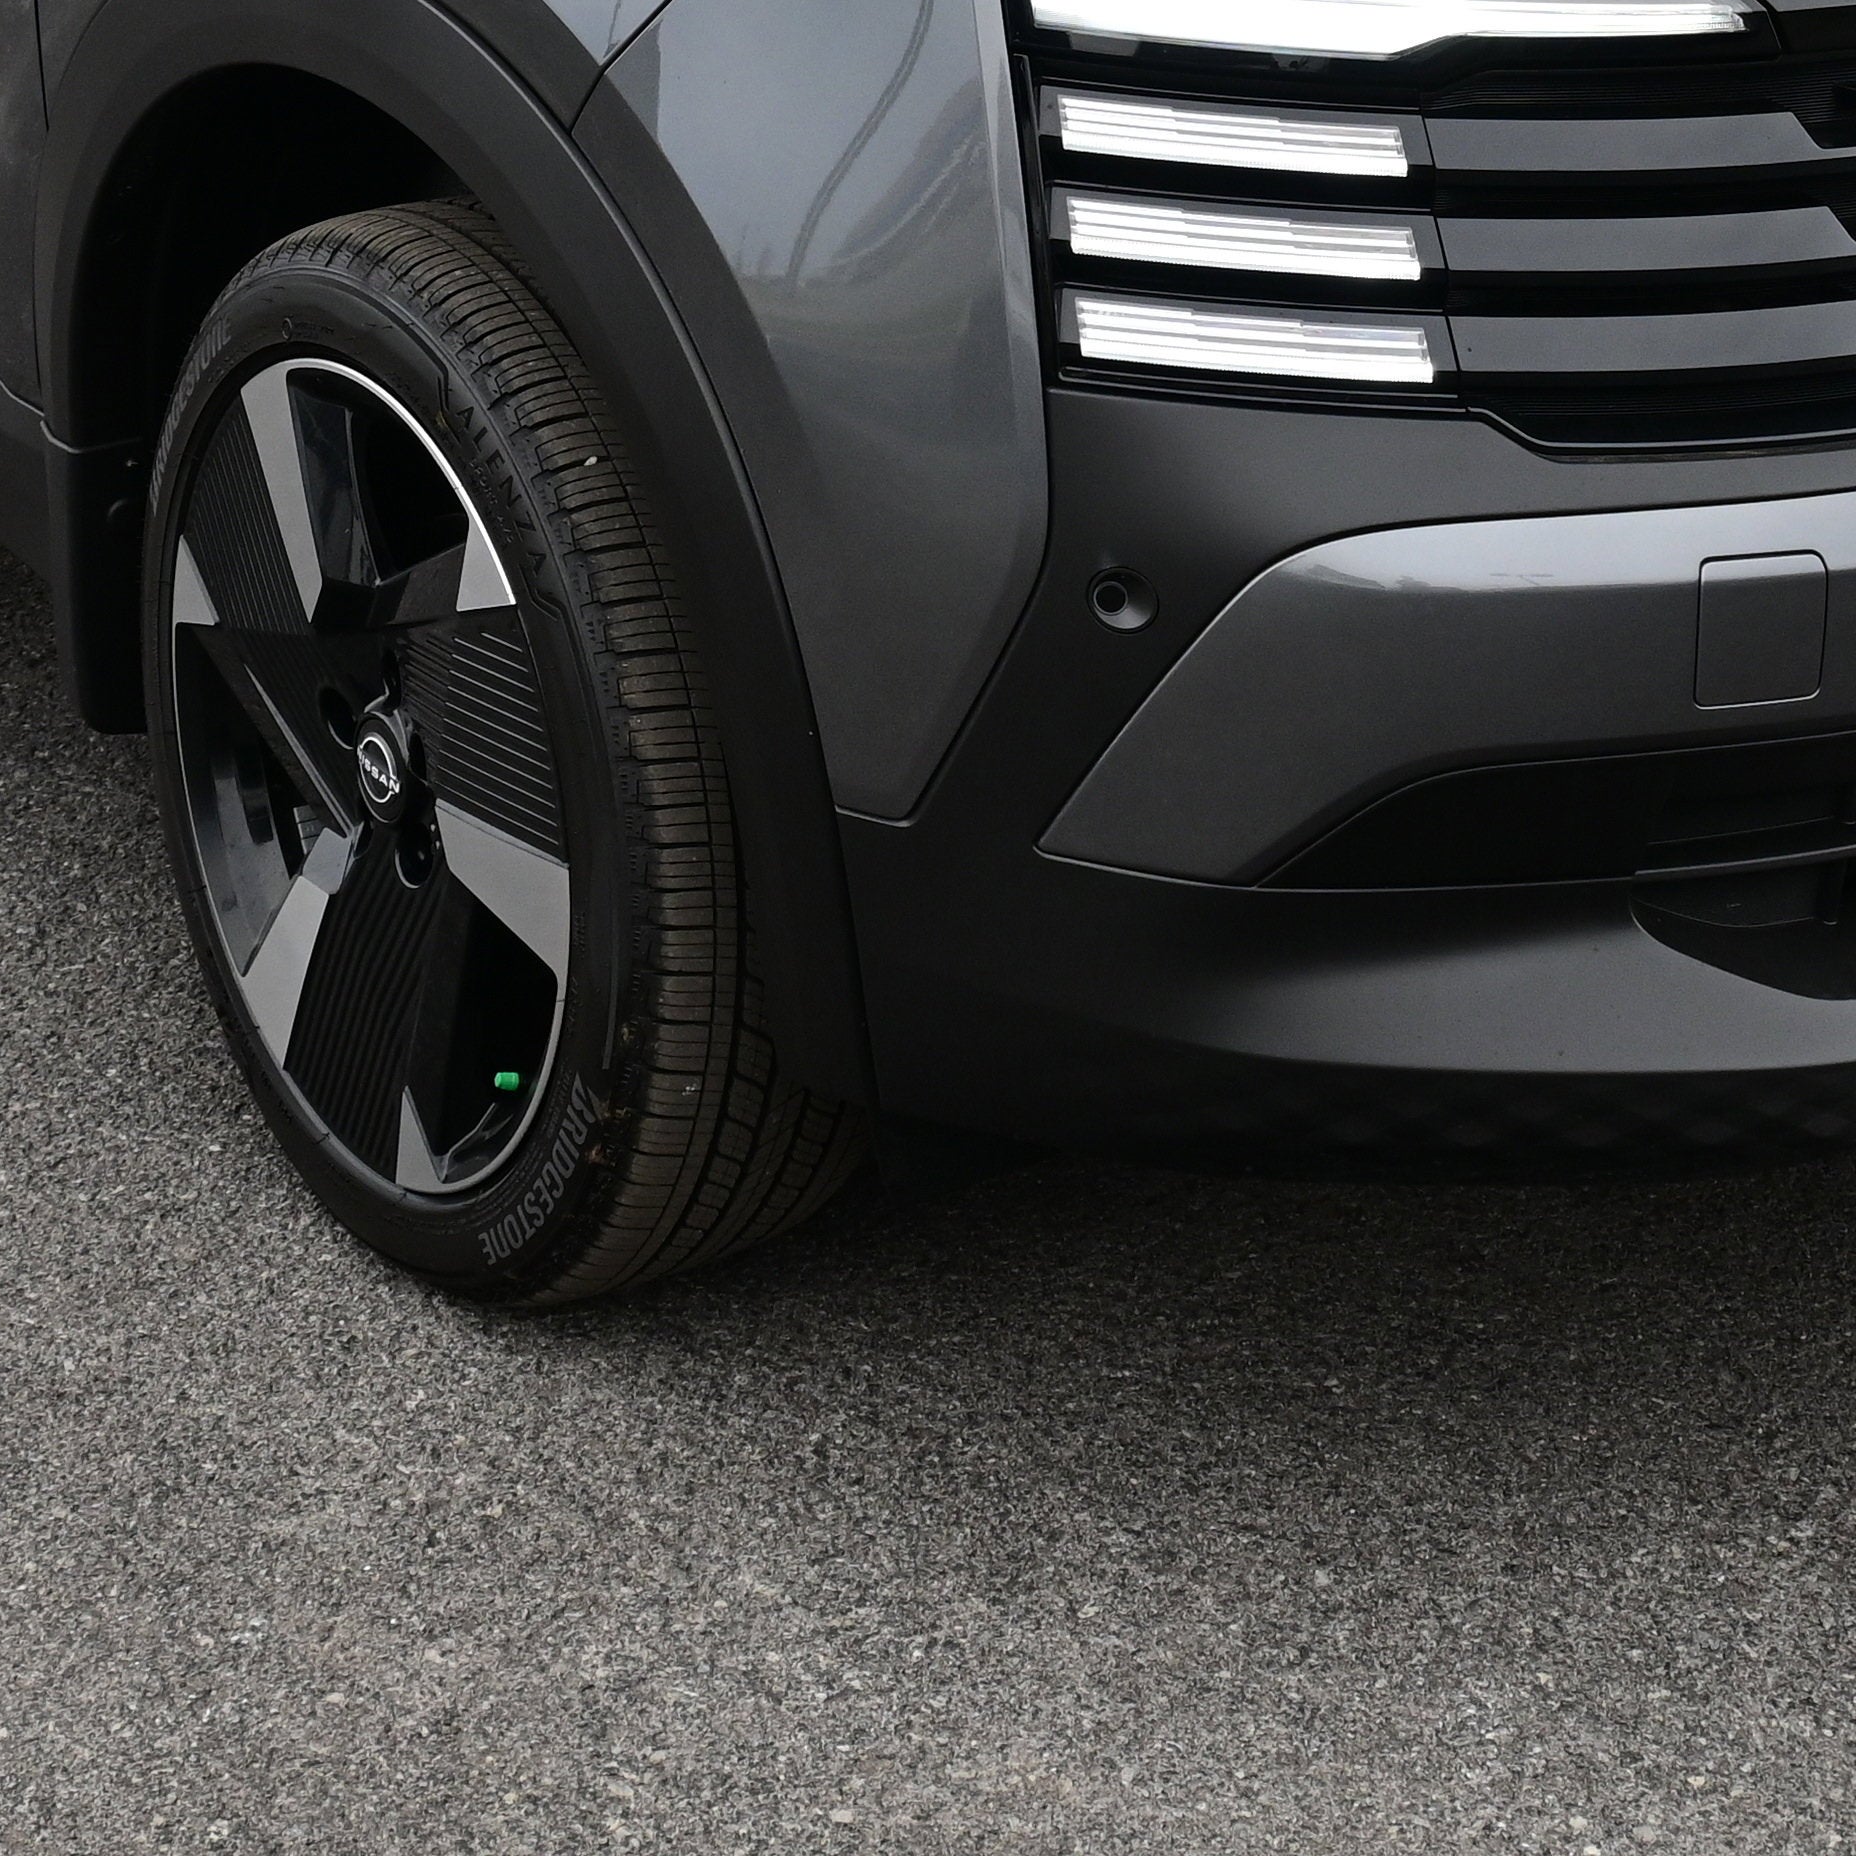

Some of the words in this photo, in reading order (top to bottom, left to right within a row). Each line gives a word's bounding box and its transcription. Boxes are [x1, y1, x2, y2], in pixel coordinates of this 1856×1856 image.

[456, 404, 547, 572] ALENZA
[356, 745, 400, 794] NISSAN
[478, 1071, 609, 1266] BRIDGESTONE
